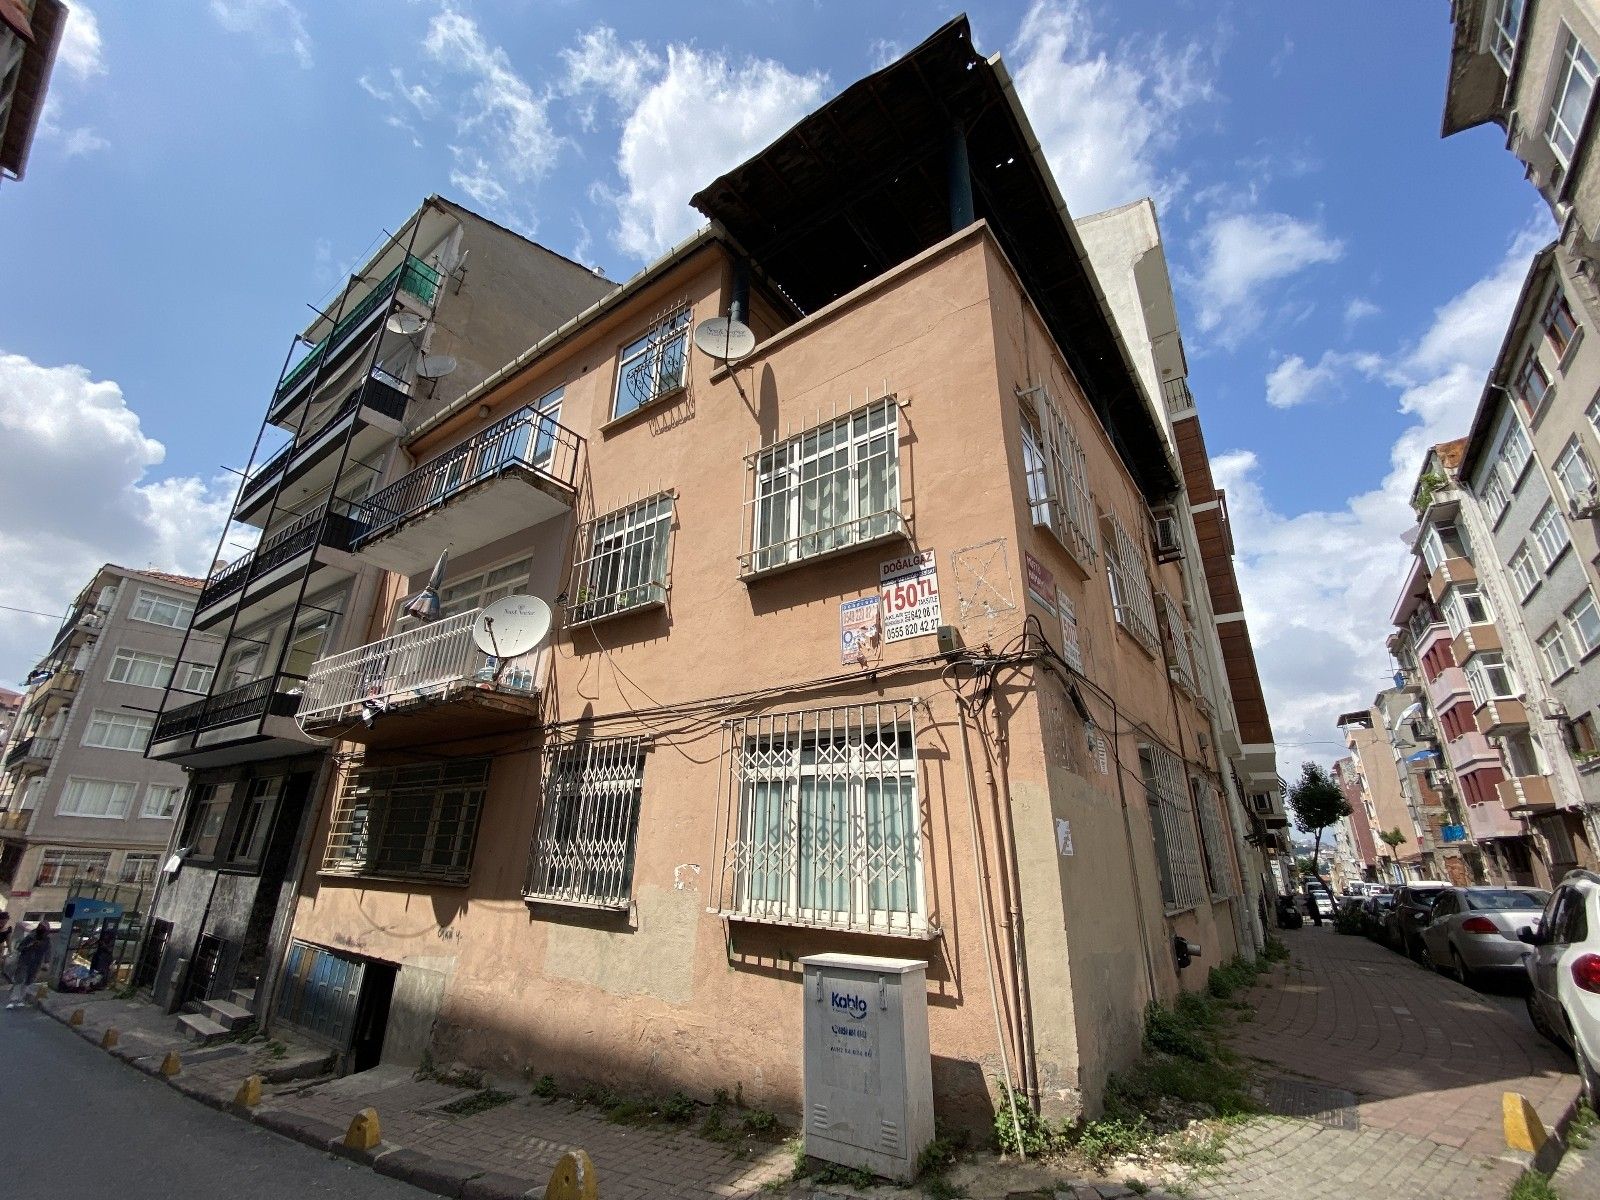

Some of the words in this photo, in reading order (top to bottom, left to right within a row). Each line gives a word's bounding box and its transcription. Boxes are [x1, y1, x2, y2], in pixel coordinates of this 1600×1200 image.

[883, 552, 932, 574] DOĞALGAZ
[886, 625, 904, 640] 0555
[904, 622, 918, 636] 820
[919, 620, 929, 632] 42
[930, 617, 940, 631] 27
[831, 991, 867, 1012] Kablo
